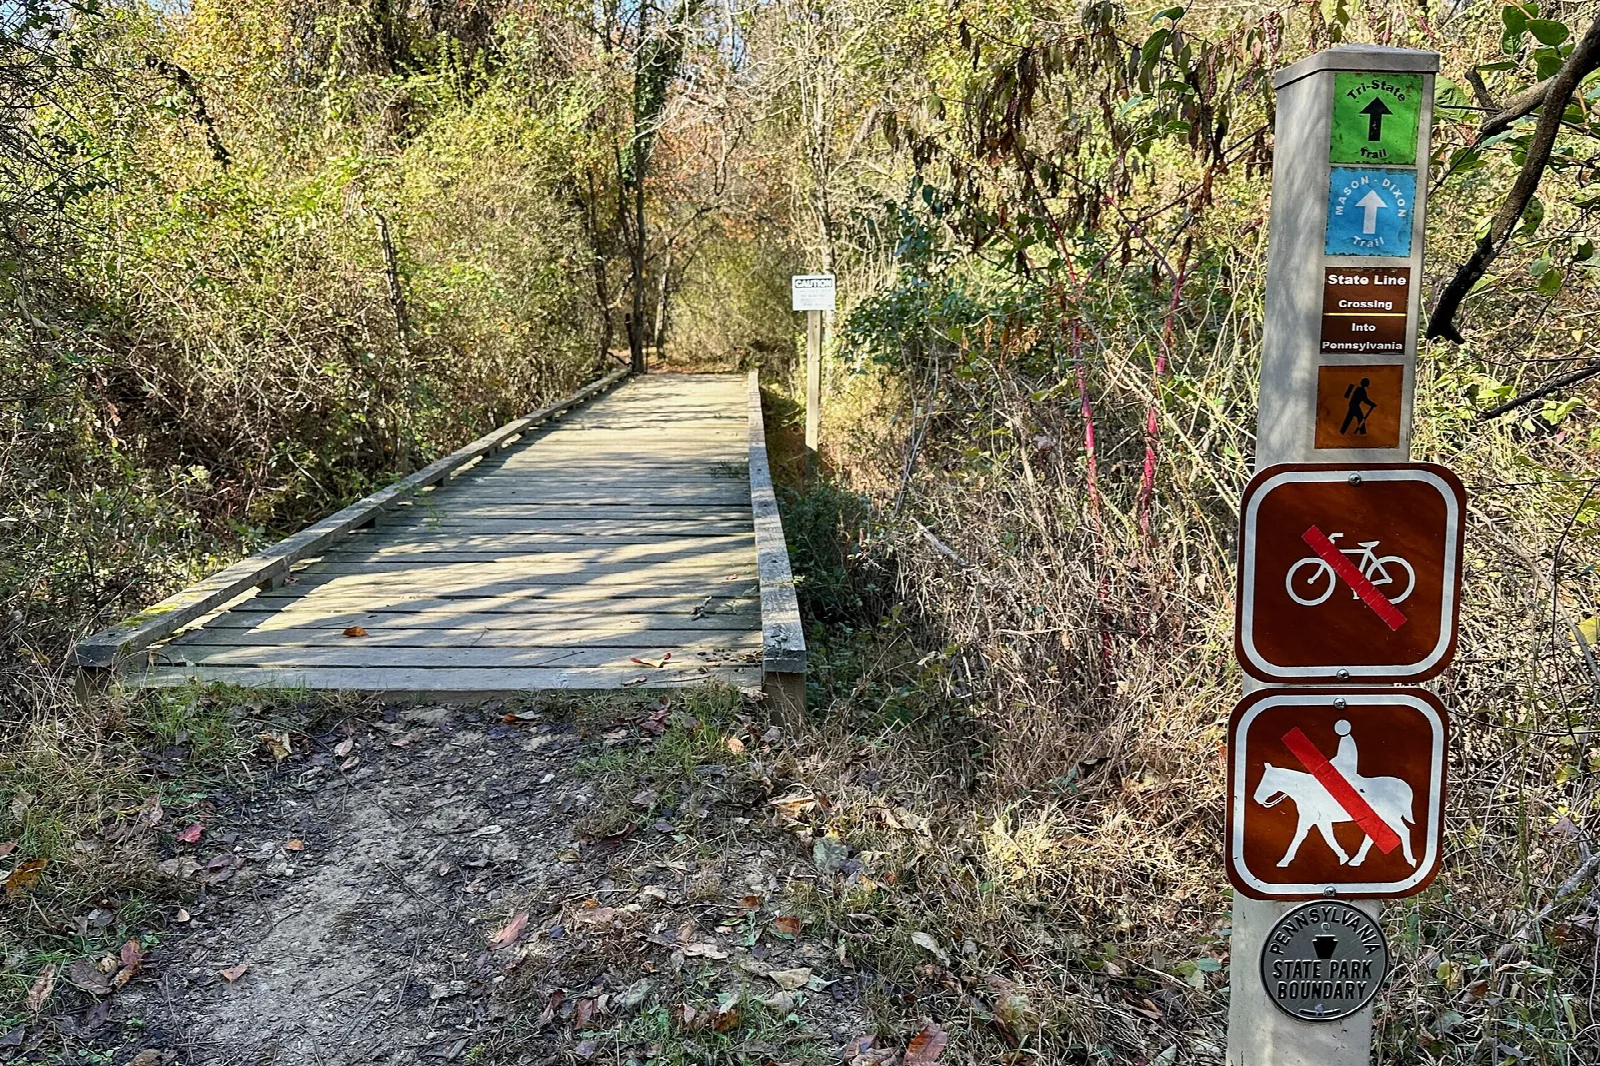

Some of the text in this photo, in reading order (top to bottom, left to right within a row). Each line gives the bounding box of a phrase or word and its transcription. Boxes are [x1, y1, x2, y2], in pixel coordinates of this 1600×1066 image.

[1346, 79, 1406, 102] Tri-State
[1360, 147, 1387, 159] Trail
[1353, 235, 1384, 247] Trail
[795, 279, 832, 288] CAUTION
[1328, 274, 1407, 286] State Line
[1338, 299, 1393, 311] Crossing
[1351, 322, 1376, 332] Into
[1322, 341, 1403, 352] Pennsylvania
[1269, 906, 1381, 955] PENNSYLVANIA
[1272, 959, 1373, 979] STATE PARK
[1277, 980, 1368, 1000] BOUNDARY
